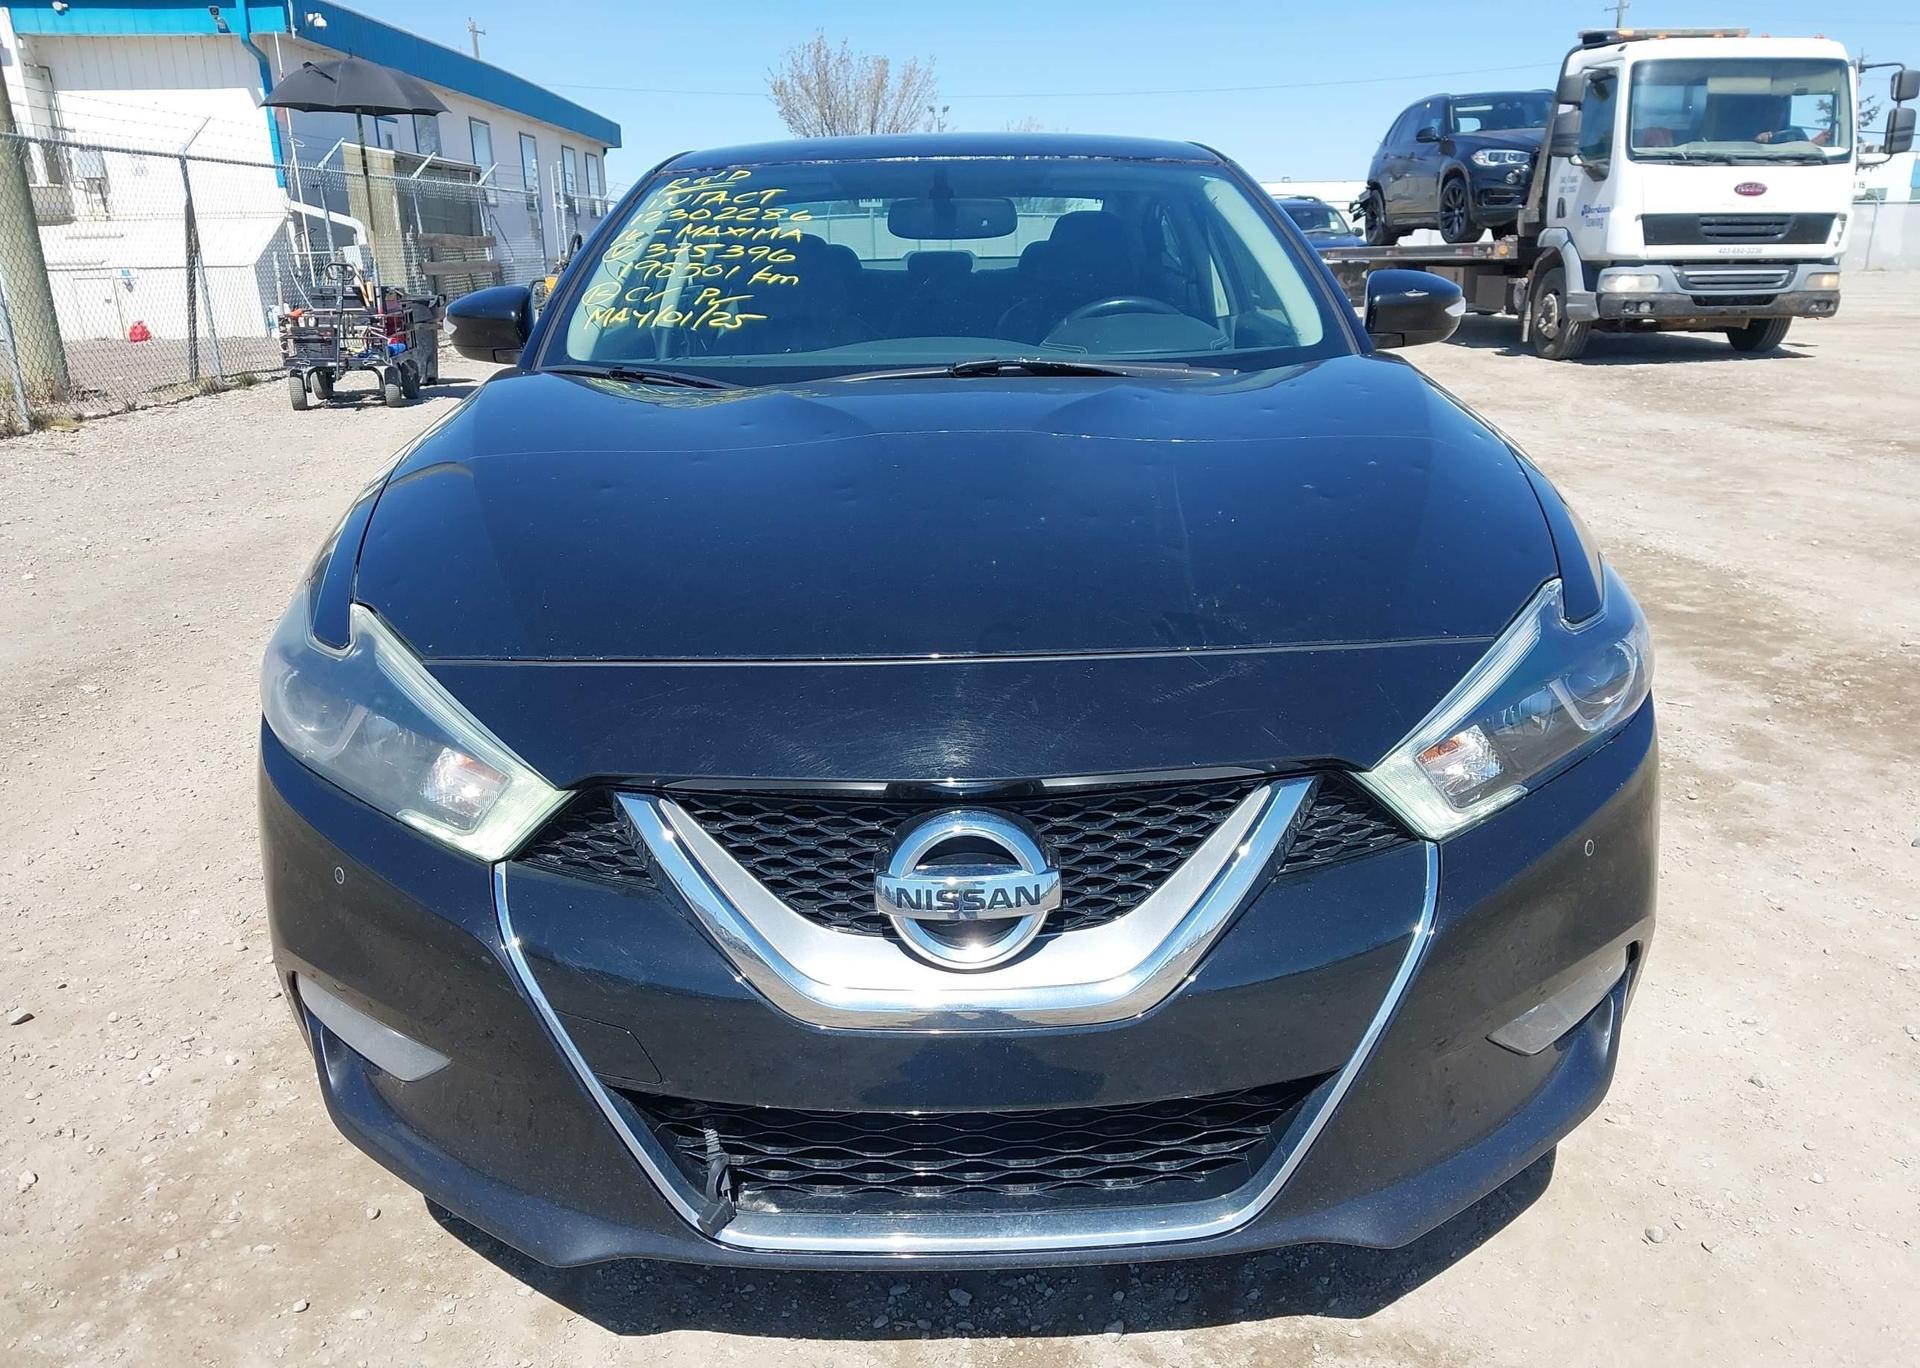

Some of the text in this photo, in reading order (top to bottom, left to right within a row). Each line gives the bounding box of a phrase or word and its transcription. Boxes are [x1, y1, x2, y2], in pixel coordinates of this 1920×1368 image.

[648, 189, 788, 210] INTACT
[631, 207, 814, 226] 12302286
[676, 223, 804, 243] MAXIMA
[645, 242, 798, 264] 375396
[584, 303, 768, 331] MAY/01/25
[895, 883, 1041, 912] NISSAN
